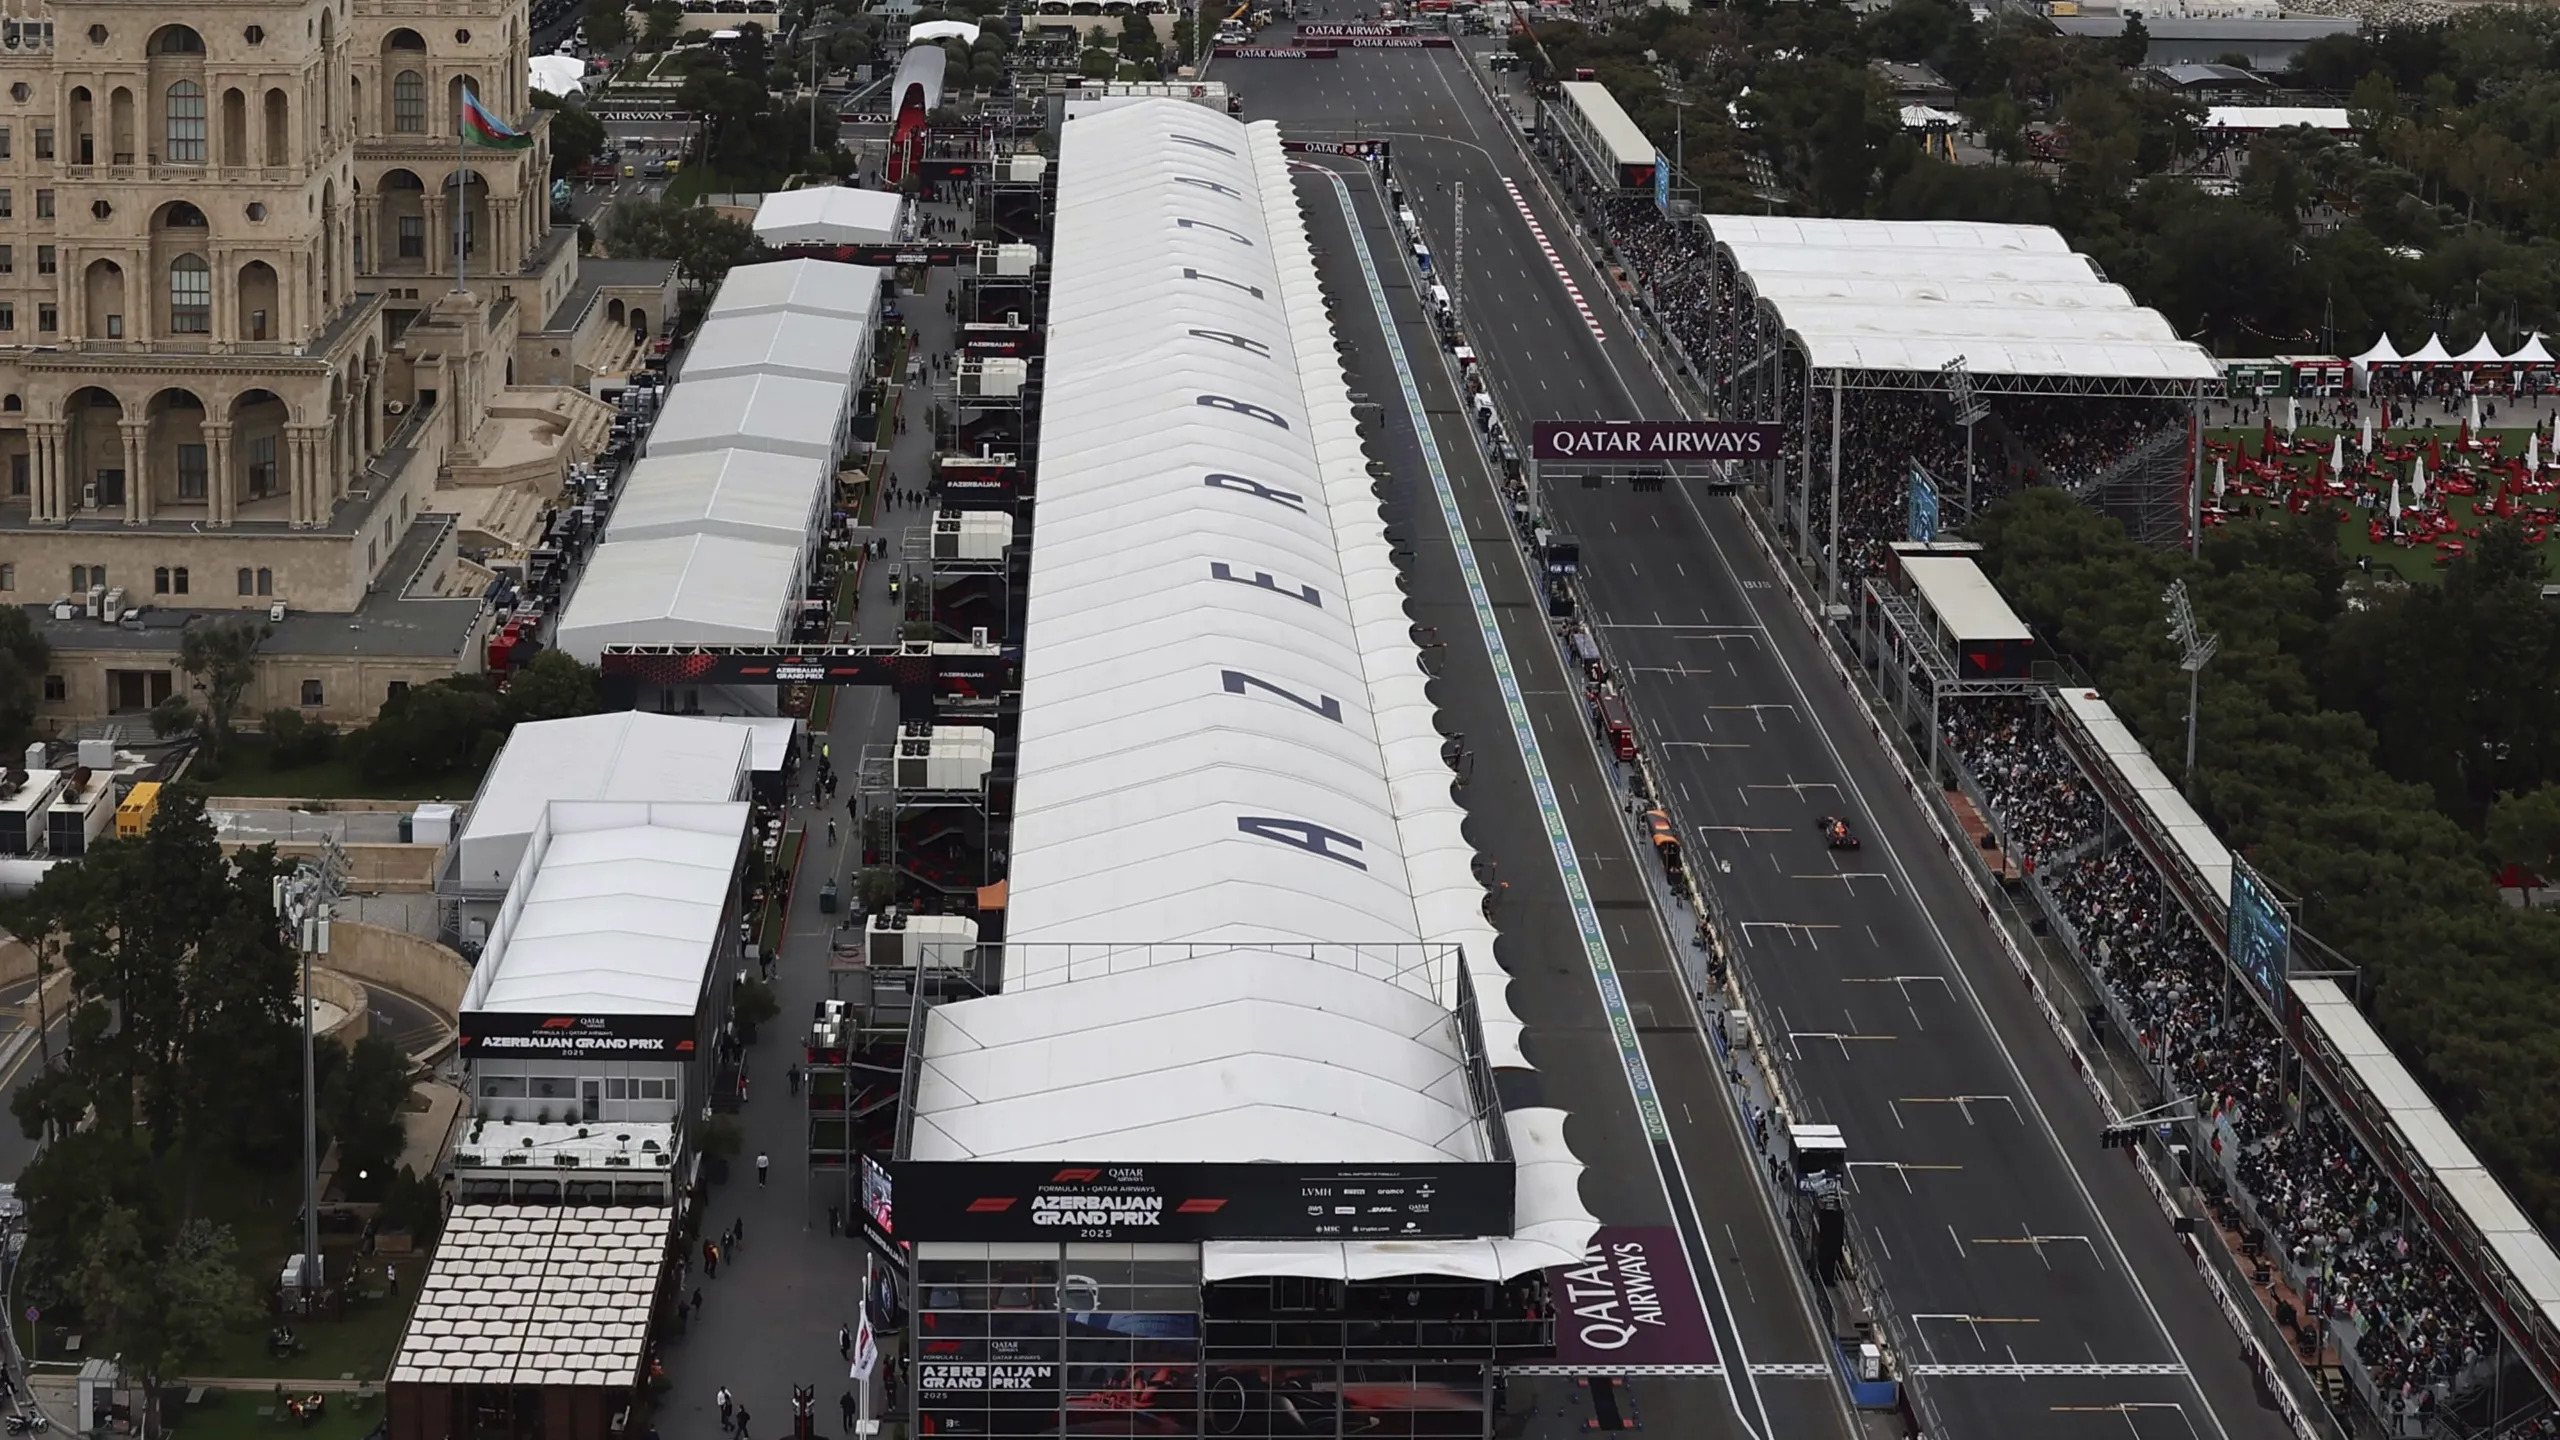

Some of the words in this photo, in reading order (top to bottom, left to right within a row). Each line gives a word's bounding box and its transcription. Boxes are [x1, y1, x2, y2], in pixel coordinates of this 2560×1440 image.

[1306, 26, 1342, 36] QATAR
[1346, 26, 1392, 36] AIRWAYS
[1353, 39, 1384, 48] QATAR
[1386, 39, 1423, 48] AIRWAYS
[1235, 49, 1268, 59] QATAR
[1268, 49, 1307, 58] AIRWAYS
[604, 112, 674, 120] AIRWAYS
[1304, 142, 1338, 155] QATAR
[1552, 431, 1642, 456] QATAR
[1649, 431, 1761, 453] AIRWAYS
[482, 1036, 574, 1048] AZERBAIJAN
[575, 1037, 628, 1049] GRAND
[628, 1038, 664, 1050] PRIX
[1642, 1100, 1664, 1134] aramco
[1108, 1168, 1143, 1178] QATAR
[1302, 1188, 1332, 1196] LVMH
[1031, 1196, 1162, 1210] AZERBAIJAN
[1032, 1211, 1107, 1226] GRAND
[1110, 1212, 1160, 1226] PRIX
[1080, 1229, 1112, 1238] 2025
[1612, 1242, 1666, 1326] AIRWAYS
[2196, 1254, 2220, 1304] QATAR
[2220, 1297, 2252, 1357] AIRWAYS
[923, 1378, 982, 1388] GRAND
[992, 1378, 1032, 1388] PRIX
